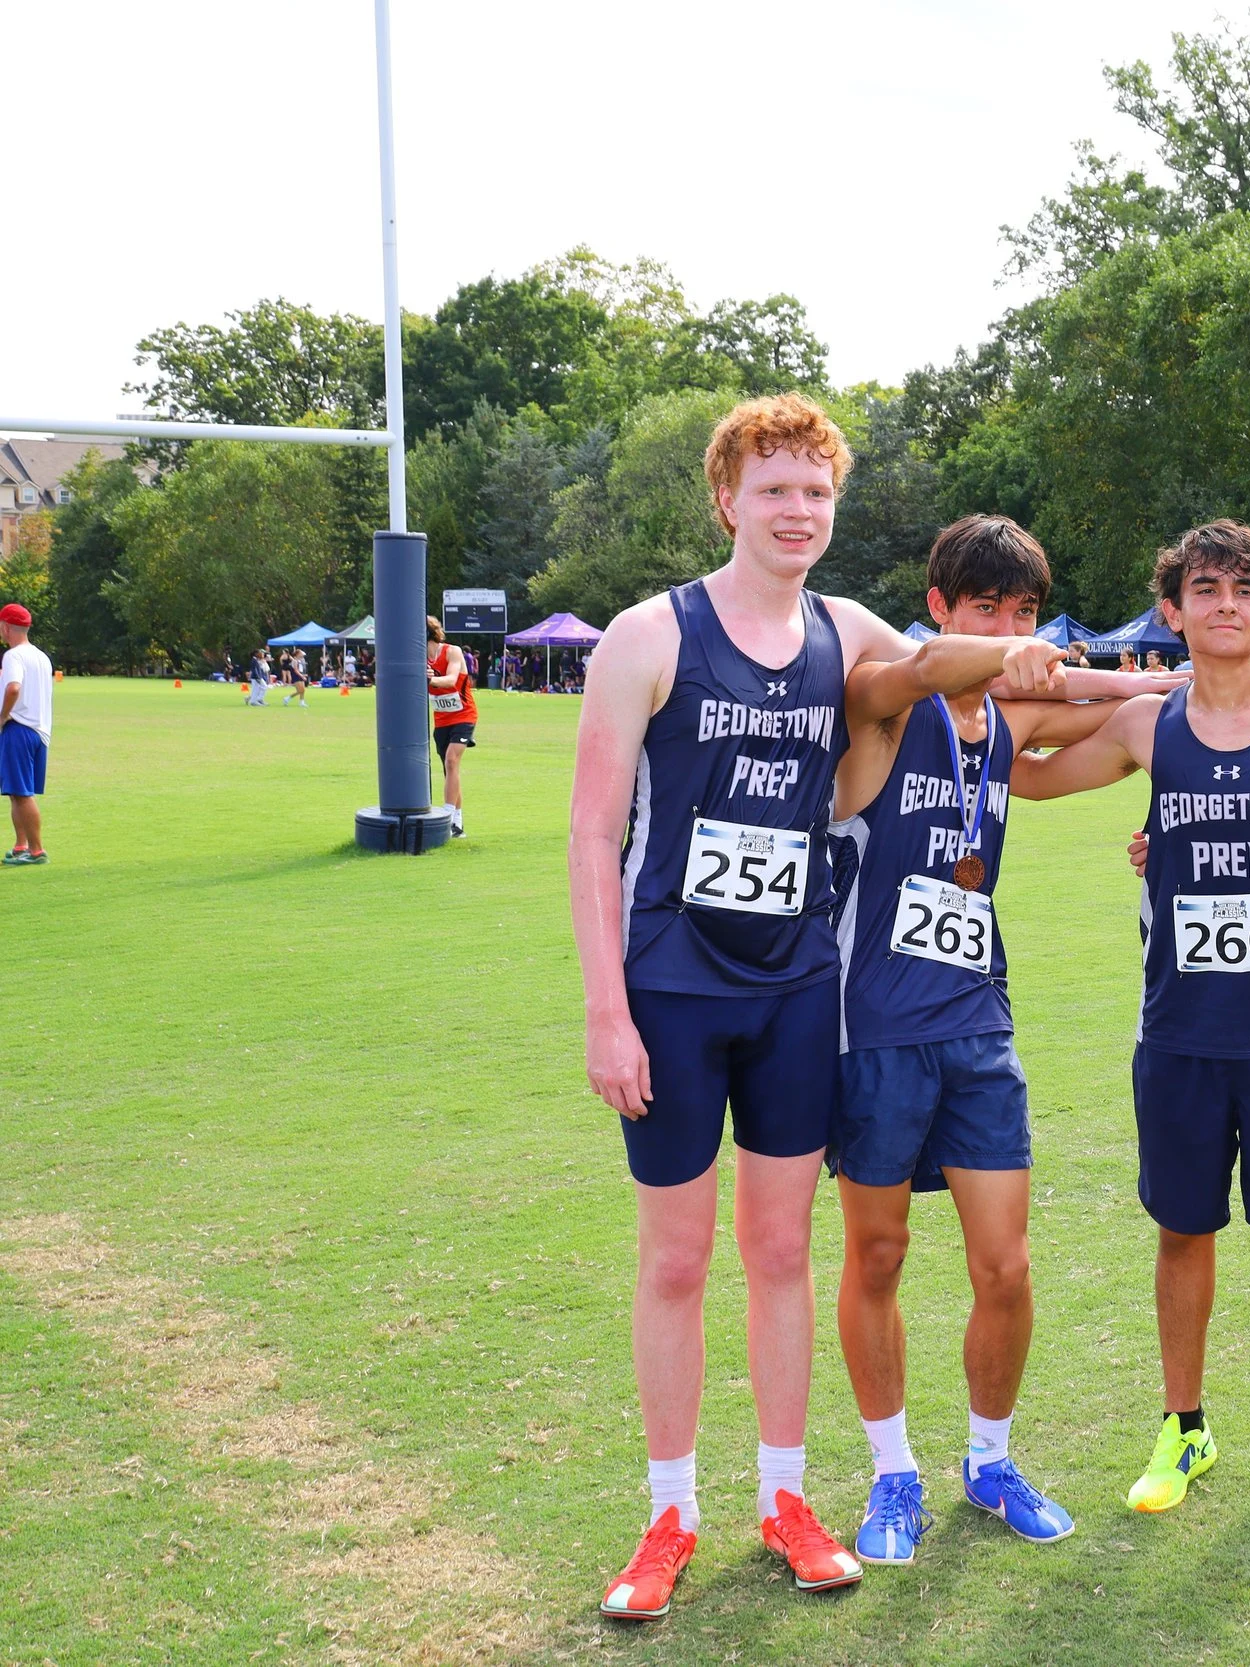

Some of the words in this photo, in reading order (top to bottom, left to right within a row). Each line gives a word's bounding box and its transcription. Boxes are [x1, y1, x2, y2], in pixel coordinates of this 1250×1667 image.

[698, 699, 835, 752] GEORGETOWN
[728, 755, 799, 800] PREP
[694, 850, 798, 906] 254
[901, 903, 985, 961] 263
